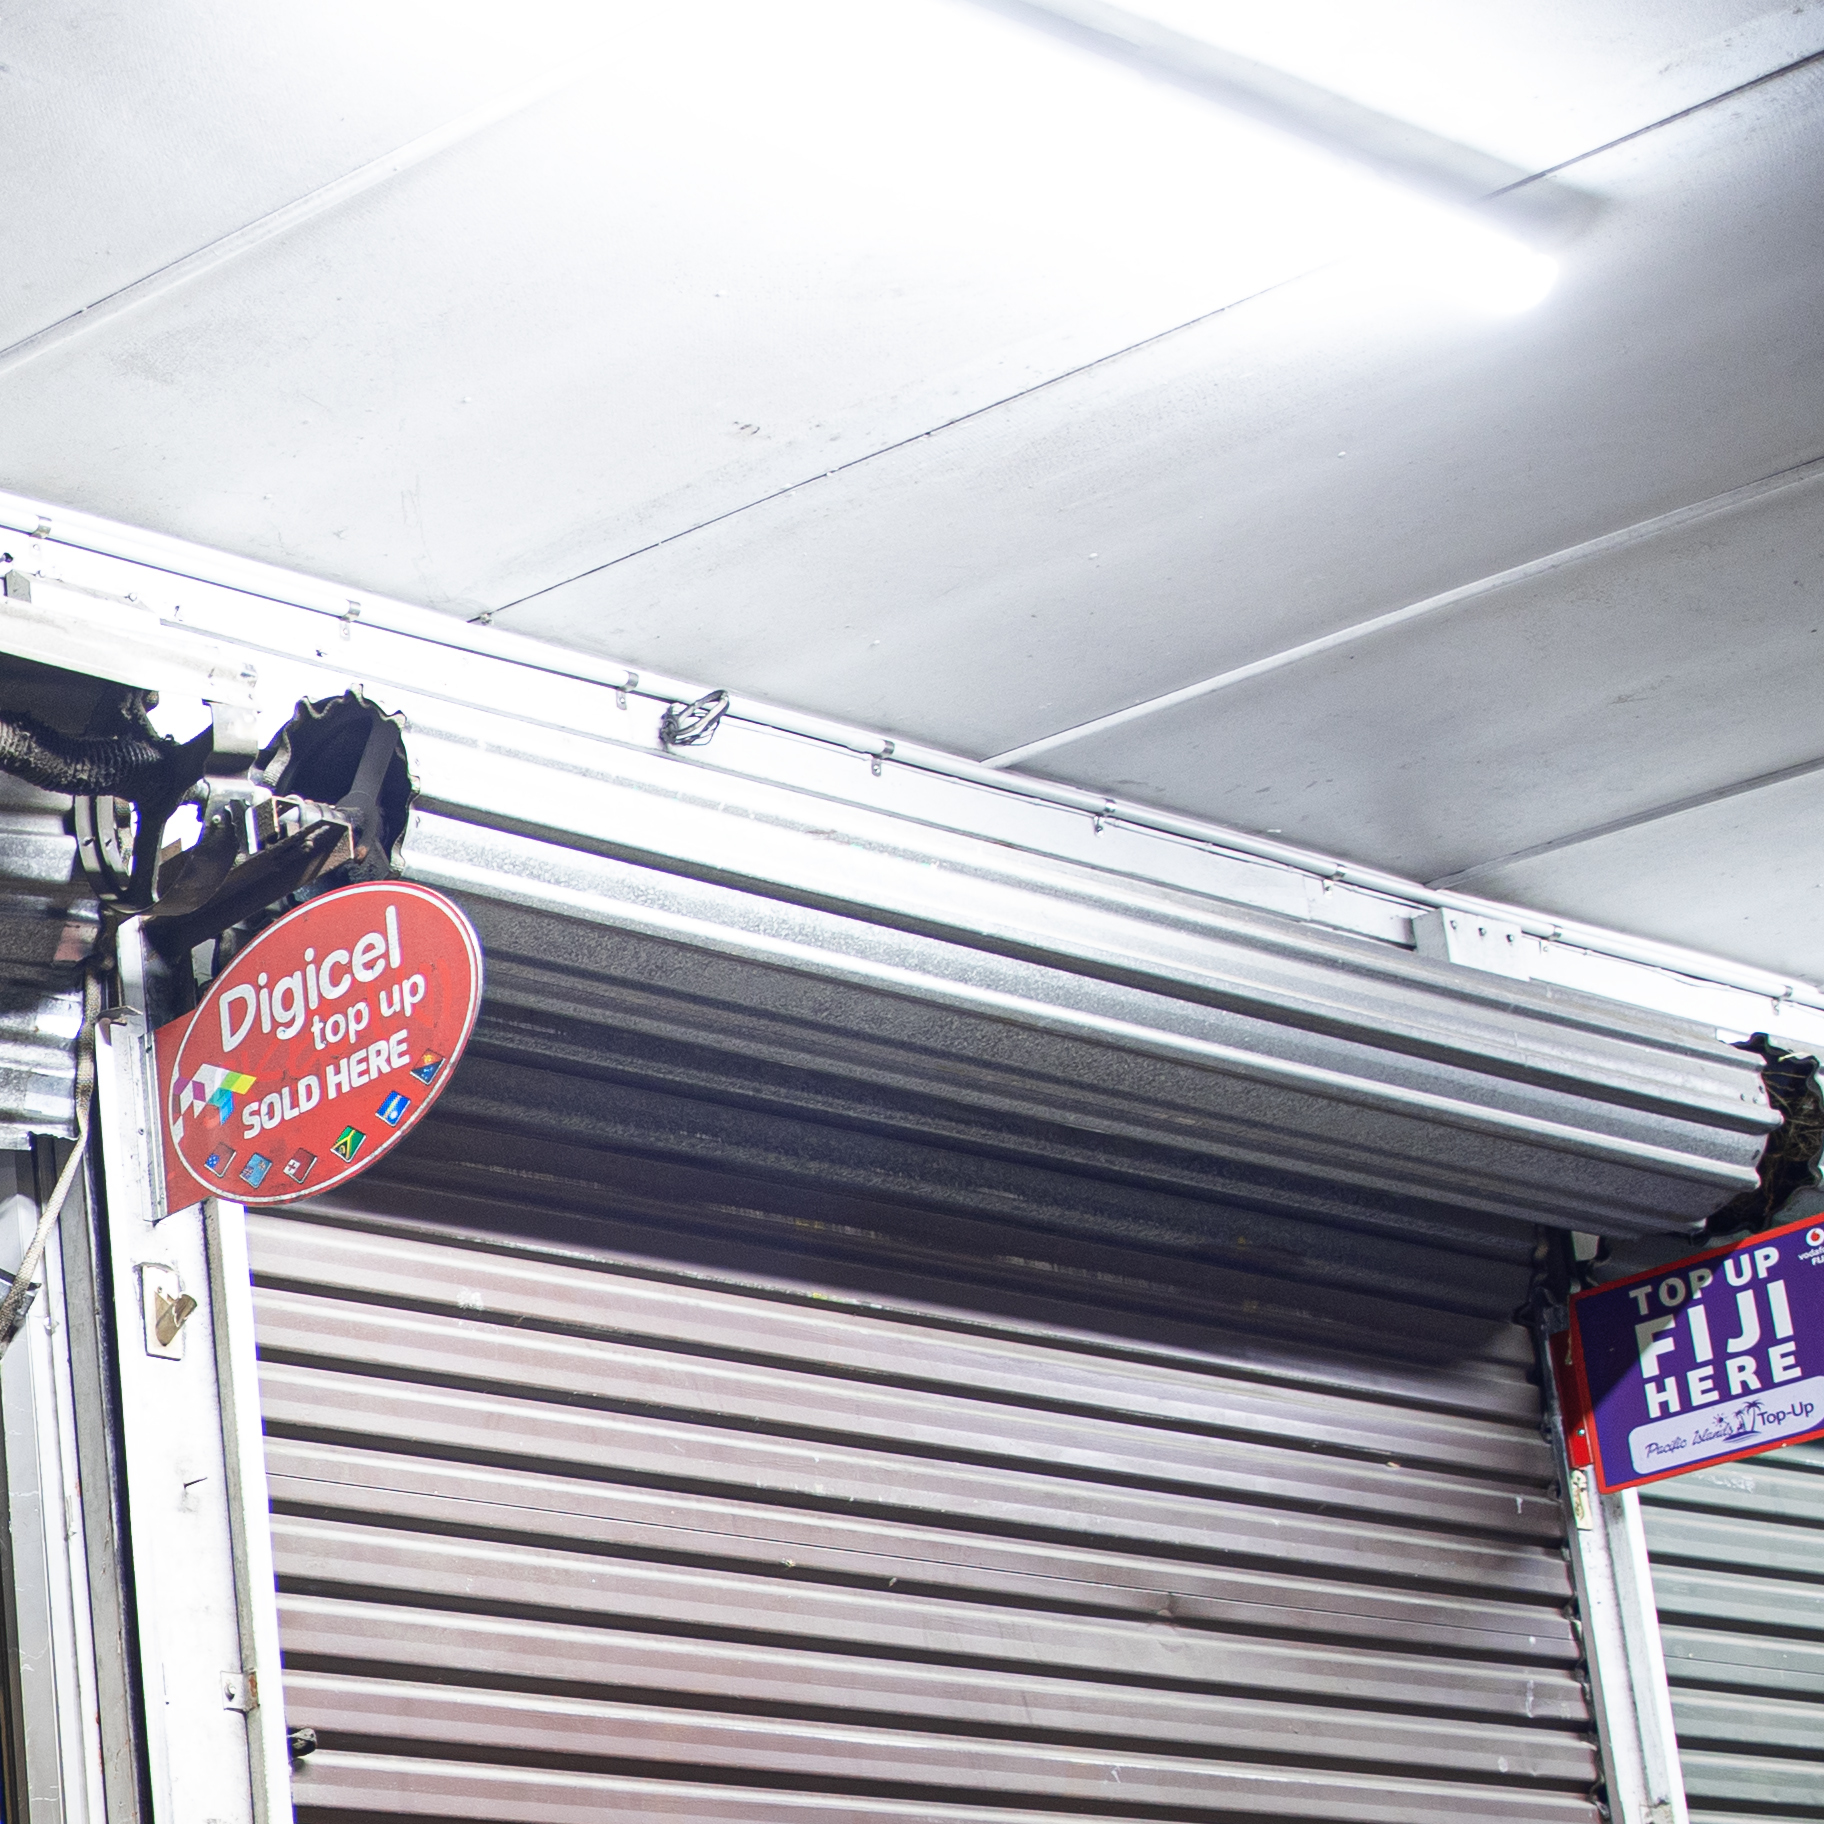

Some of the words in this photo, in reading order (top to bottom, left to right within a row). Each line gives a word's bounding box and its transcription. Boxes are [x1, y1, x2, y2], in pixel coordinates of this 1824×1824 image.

[219, 905, 402, 1053] Digicel
[312, 999, 369, 1050] top
[379, 973, 426, 1016] up
[241, 1074, 320, 1140] SOLD
[327, 1029, 411, 1100] HERE
[1629, 1268, 1713, 1315] TOP
[1723, 1246, 1780, 1287] UP
[1635, 1279, 1794, 1379] FIJI
[1644, 1340, 1802, 1419] HERE
[1644, 1437, 1687, 1458] Pacific
[1692, 1423, 1734, 1447] Islands
[1757, 1402, 1814, 1427] Top-Up
